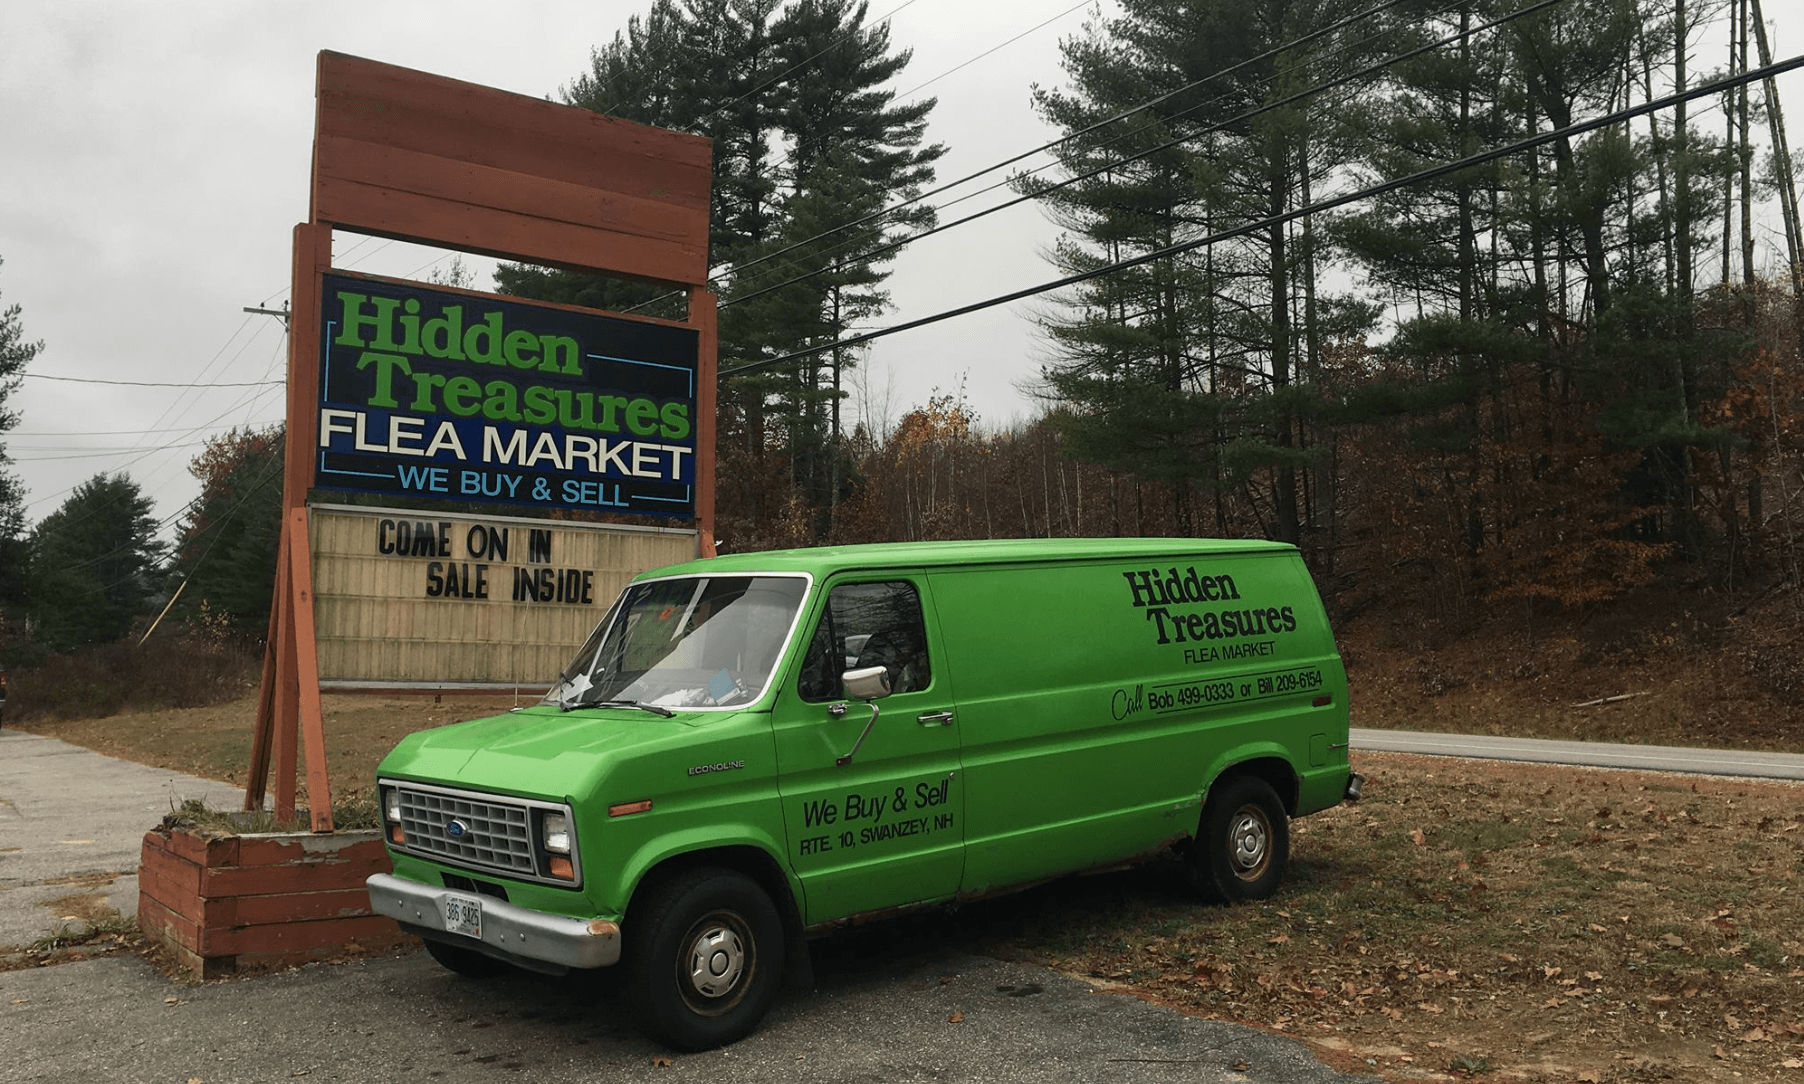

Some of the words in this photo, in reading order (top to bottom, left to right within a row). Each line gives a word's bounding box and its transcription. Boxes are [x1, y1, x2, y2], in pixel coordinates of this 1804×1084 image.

[335, 291, 583, 376] Hidden
[356, 351, 691, 440] Treasures
[320, 408, 467, 461] FLEA
[482, 425, 692, 480] MARKET
[398, 464, 449, 492] WE
[460, 470, 523, 498] BUY
[532, 477, 552, 501] &
[561, 480, 630, 507] SELL
[379, 518, 451, 557] COME
[467, 524, 508, 561] ON
[529, 529, 552, 563] IN
[426, 562, 488, 599] SALE
[513, 566, 594, 604] INSIDE
[1122, 566, 1241, 607] Hidden
[1146, 605, 1297, 645] Treasures
[1183, 645, 1220, 664] FLEA
[1222, 641, 1276, 660] MARKET
[1112, 684, 1143, 721] Call
[1148, 690, 1175, 710] Bob
[1178, 682, 1235, 705] 499-0333
[1240, 683, 1252, 697] or
[1257, 676, 1274, 694] Bill
[1275, 670, 1322, 692] 209-6154
[688, 760, 745, 776] ECONOLINE
[803, 799, 838, 828] We
[844, 794, 887, 823] Buy
[891, 787, 908, 813] &
[914, 779, 949, 809] Sell
[800, 836, 833, 856] RTE.
[838, 832, 856, 849] 10,
[860, 817, 931, 844] SWANZEY,
[933, 813, 954, 831] NH
